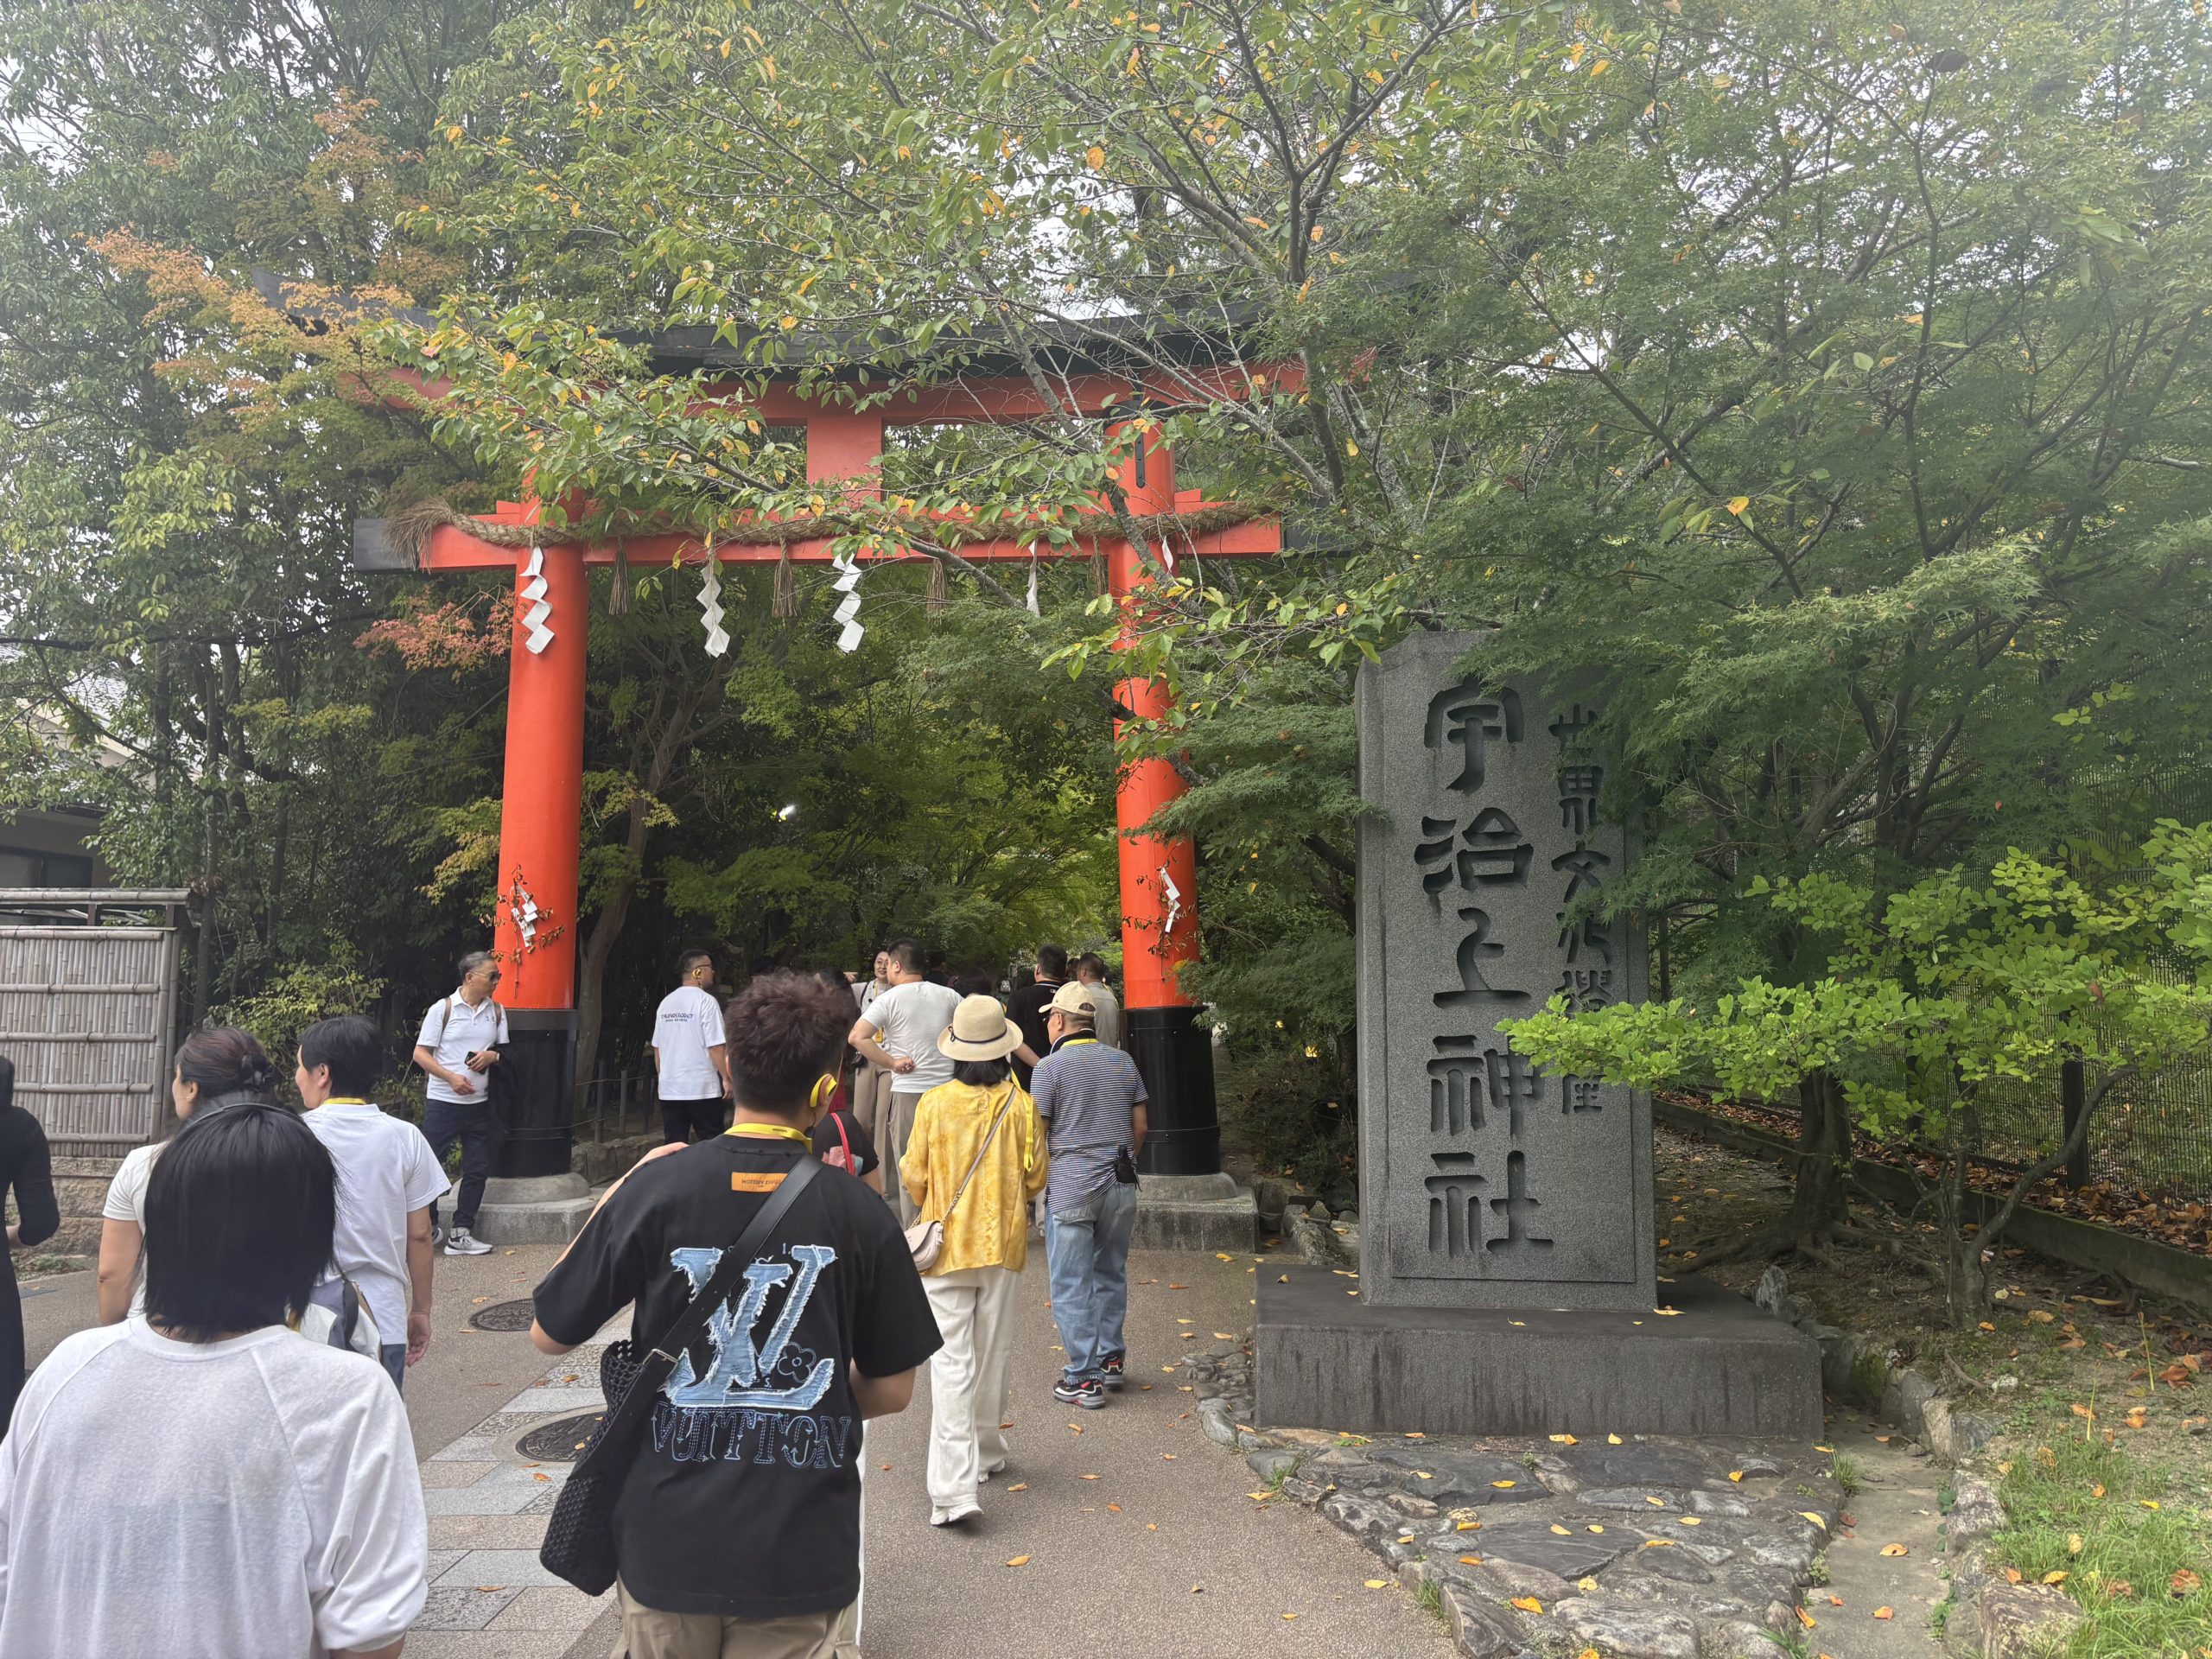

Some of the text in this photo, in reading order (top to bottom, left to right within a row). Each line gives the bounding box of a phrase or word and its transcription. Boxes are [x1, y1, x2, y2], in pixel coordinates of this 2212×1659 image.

[1414, 677, 1554, 1258] 宇治上神社
